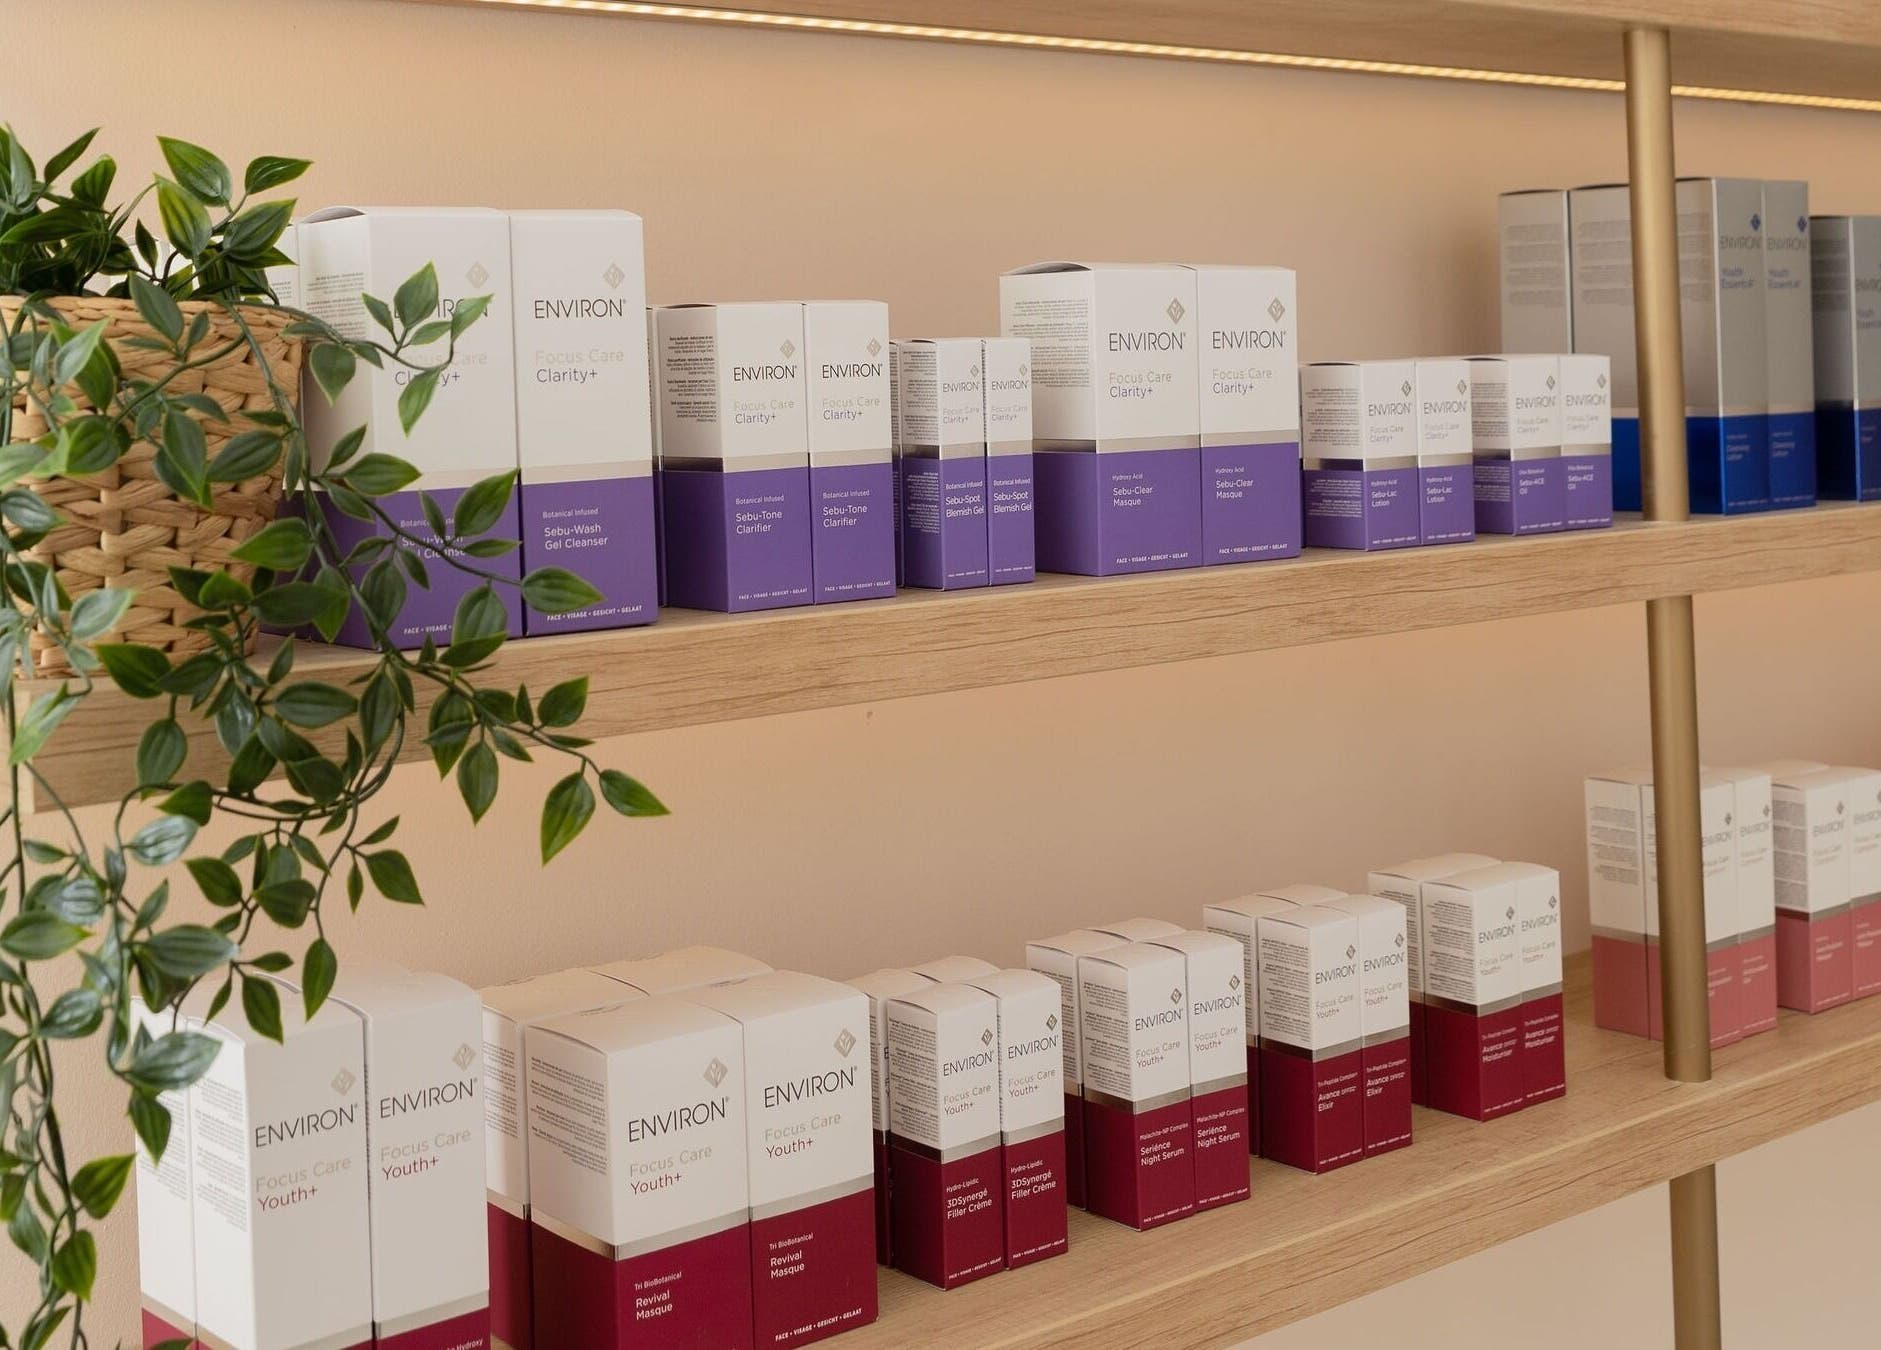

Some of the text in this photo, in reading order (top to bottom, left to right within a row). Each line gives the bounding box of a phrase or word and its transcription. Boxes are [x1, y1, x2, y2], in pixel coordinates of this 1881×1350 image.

[535, 348, 624, 364] Focus Care
[536, 368, 598, 384] Clarity+
[1109, 370, 1172, 384] Focus Care
[1212, 368, 1272, 380] Focus Care
[1110, 386, 1152, 398] Clarity+
[1213, 382, 1254, 395] Clarity+
[734, 400, 794, 411] Focus Care
[822, 397, 880, 408] Focus Care
[735, 414, 776, 425] Clarity+
[823, 410, 862, 421] Clarity+
[1216, 479, 1253, 489] Sebu-Clear
[823, 491, 849, 499] Botanical
[994, 491, 1028, 501] Sebu-Spot
[1113, 486, 1152, 496] Sebu-Clear
[1216, 491, 1243, 500] Masque
[1371, 490, 1396, 498] Sebu-Lac
[1427, 487, 1452, 495] Sebu-Lac
[736, 494, 784, 504] Botanical Infused
[946, 494, 980, 505] Sebu-Spot
[1114, 498, 1141, 507] Masque
[1427, 496, 1445, 504] Lotion
[542, 508, 599, 519] Botanical Infused
[823, 505, 868, 516] Sebu-Tone
[946, 505, 984, 518] Blemish Gel
[994, 503, 1032, 513] Blemish Gel
[736, 510, 782, 522] Sebu-Tone
[824, 517, 857, 528] Clarifier
[544, 523, 602, 537] Sebu-Wash
[736, 523, 771, 534] Clarifier
[544, 536, 608, 550] Gel Cleanser
[1194, 1026, 1238, 1042] Focus Care
[1136, 1041, 1180, 1058] Focus Care
[1195, 1040, 1221, 1051] Youth+
[1137, 1055, 1164, 1068] Youth+
[1009, 1069, 1056, 1087] Focus Care
[1367, 1076, 1389, 1087] Avance
[944, 1084, 991, 1105] Focus Care
[1009, 1085, 1038, 1098] Youth+
[1318, 1090, 1340, 1101] Avance
[1367, 1087, 1383, 1097] Elixir
[944, 1102, 973, 1117] Youth+
[1318, 1101, 1334, 1112] Elixir
[765, 1113, 841, 1142] Focus Care
[380, 1128, 471, 1162] Focus Care
[1198, 1132, 1240, 1148] Night Serum
[766, 1137, 814, 1159] Youth+
[630, 1145, 712, 1177] Focus Care
[1141, 1148, 1184, 1166] Night Serum
[256, 1157, 351, 1192] Focus Care
[382, 1156, 439, 1180] Youth+
[630, 1172, 682, 1196] Youth+
[1011, 1169, 1052, 1189] 3DSynergé
[1011, 1180, 1056, 1200] Filler Crème
[258, 1185, 318, 1212] Youth+
[947, 1188, 988, 1208] 3DSynergé
[947, 1199, 992, 1220] Filler Crème
[769, 1232, 813, 1250] Tri BioBotanical
[770, 1250, 802, 1266] Revival
[771, 1262, 805, 1280] Masque
[635, 1271, 682, 1291] Tri BioBotanical
[636, 1290, 670, 1309] Revival
[636, 1303, 673, 1321] Masque
[775, 1308, 862, 1342] FACE VISAGE GESICHT GELAAT
